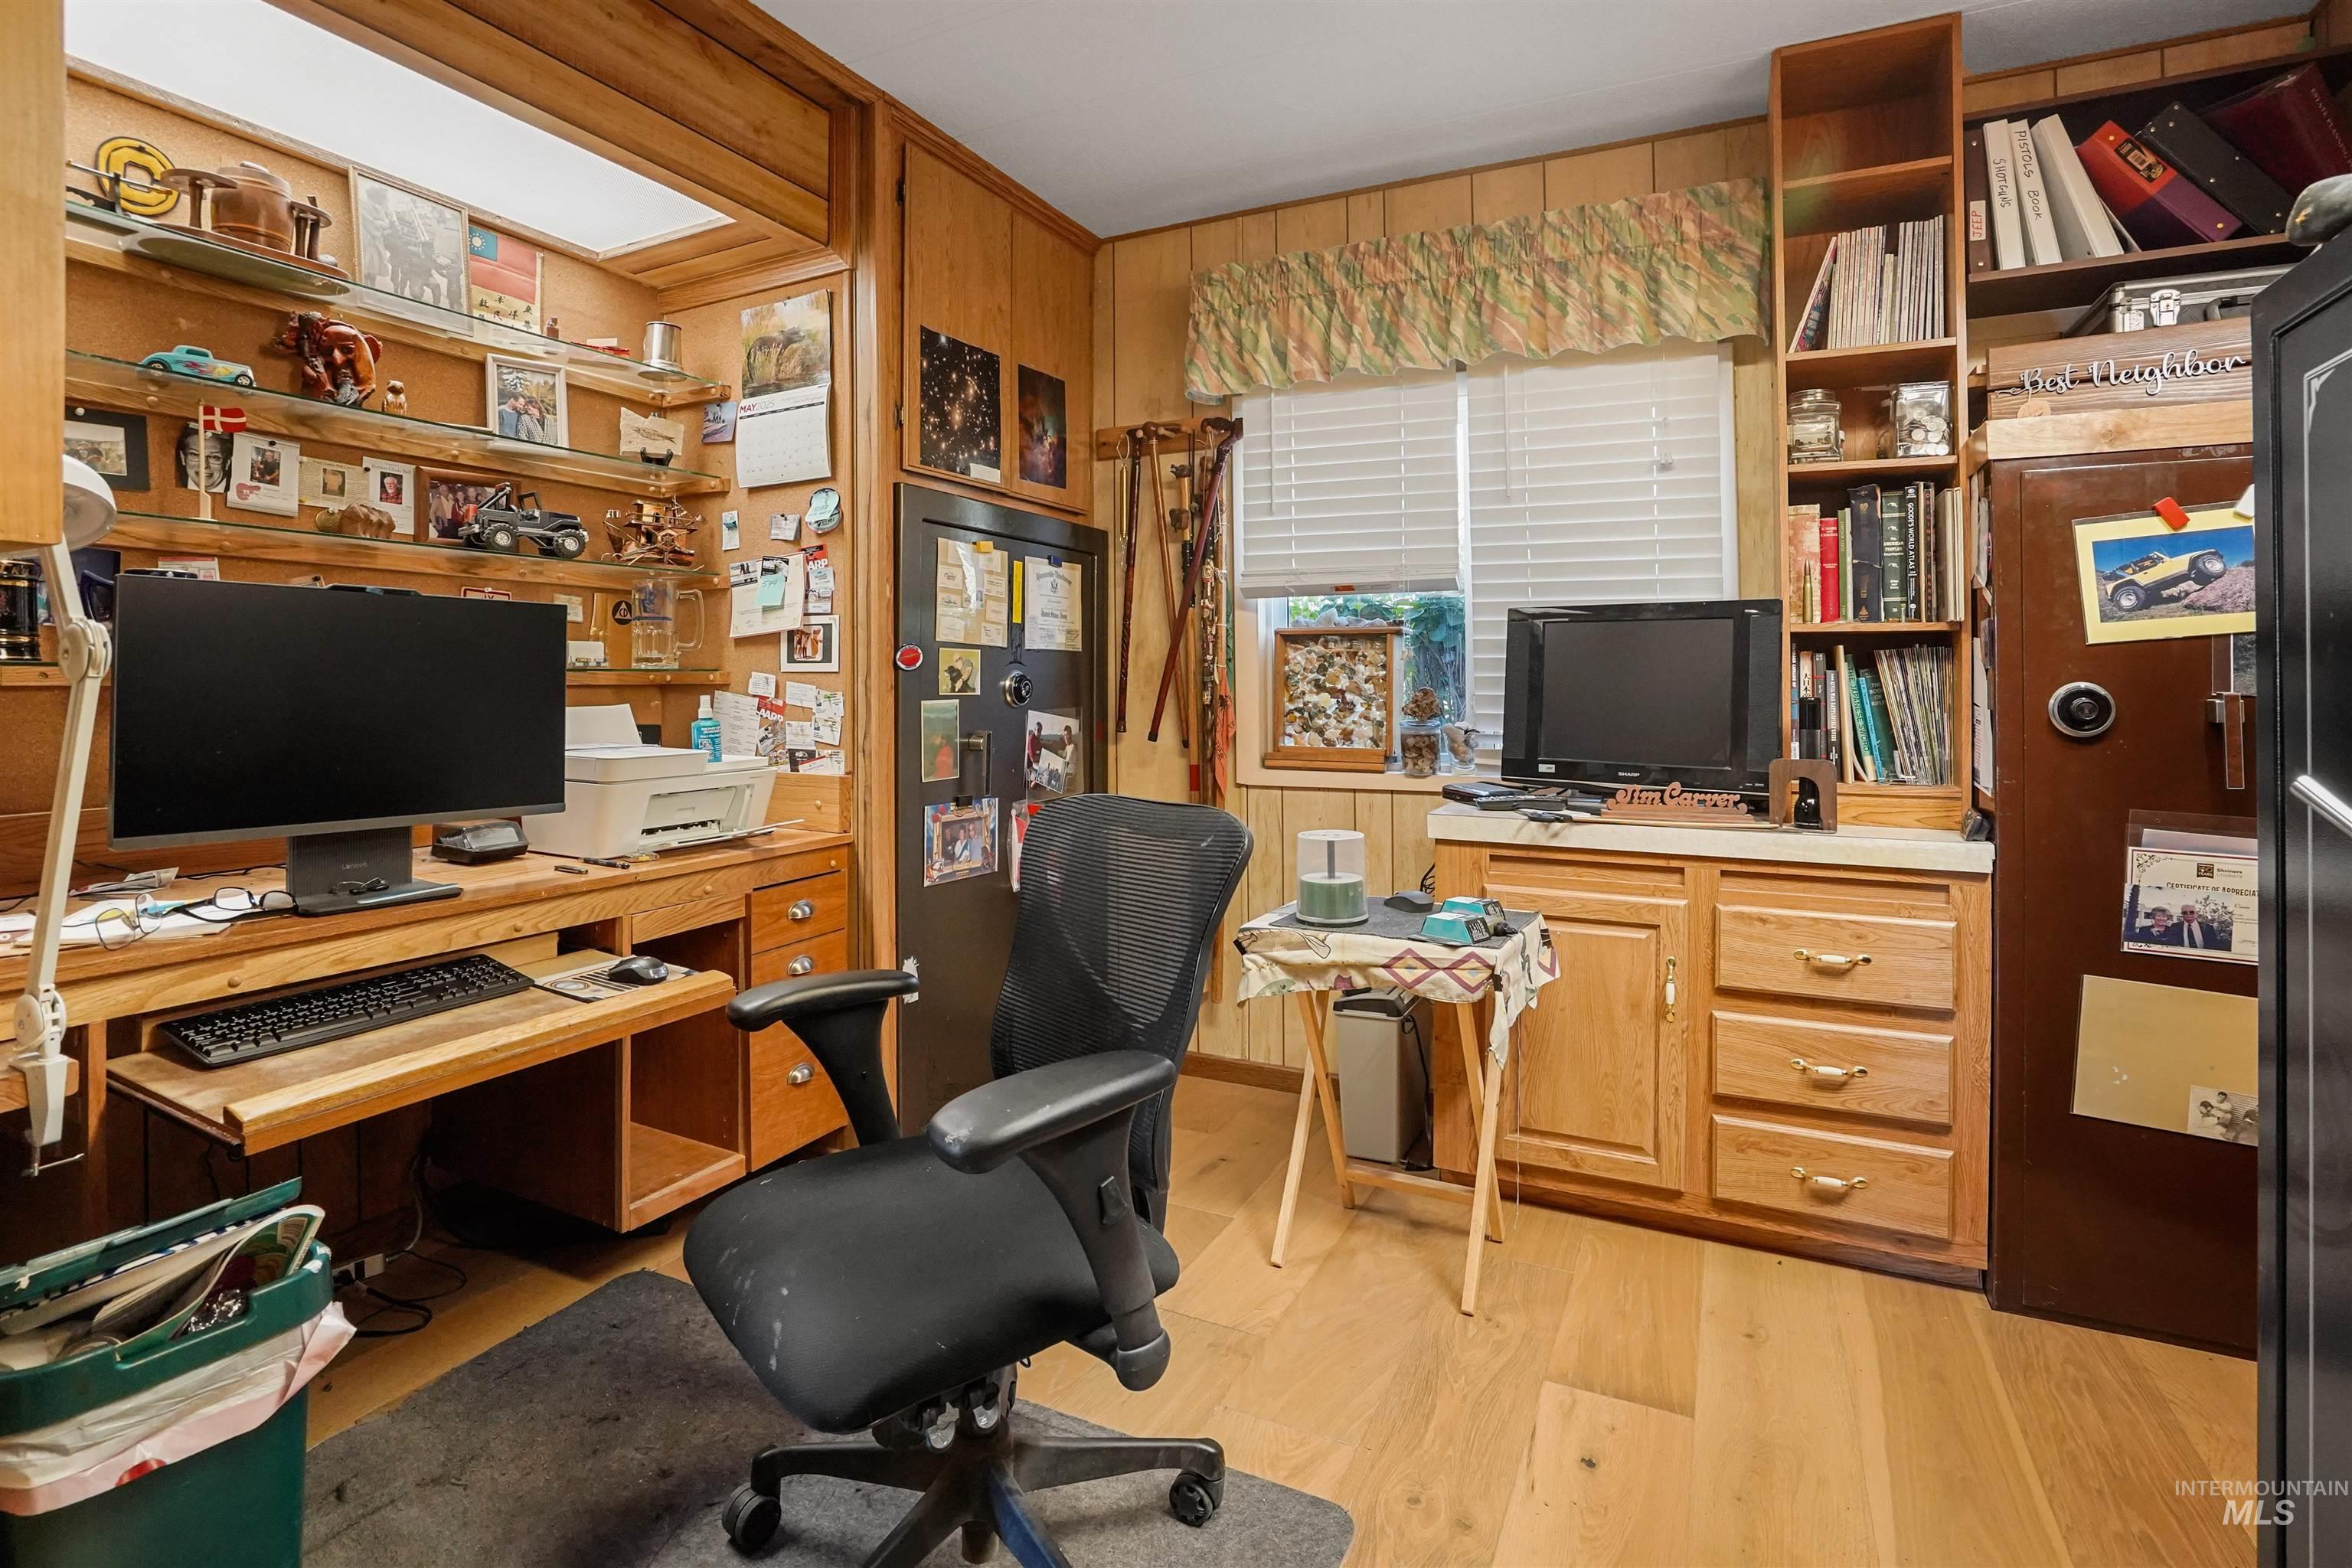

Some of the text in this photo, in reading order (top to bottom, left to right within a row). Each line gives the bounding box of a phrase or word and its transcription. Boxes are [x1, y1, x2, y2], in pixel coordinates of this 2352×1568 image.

[1993, 158, 2011, 208] SHOTGUNS
[2015, 130, 2043, 221] PISTOLS BOOK
[1971, 211, 1983, 238] JEEP
[2003, 349, 2247, 396] Best Neighbor
[740, 403, 756, 413] MAY
[756, 399, 775, 410] 2025
[808, 559, 828, 570] ARP
[619, 608, 628, 618] CD
[1851, 685, 1864, 723] JAPANESE
[1859, 723, 1869, 752] SWORD
[759, 733, 769, 744] NRA
[1615, 781, 1740, 808] Jim Carver
